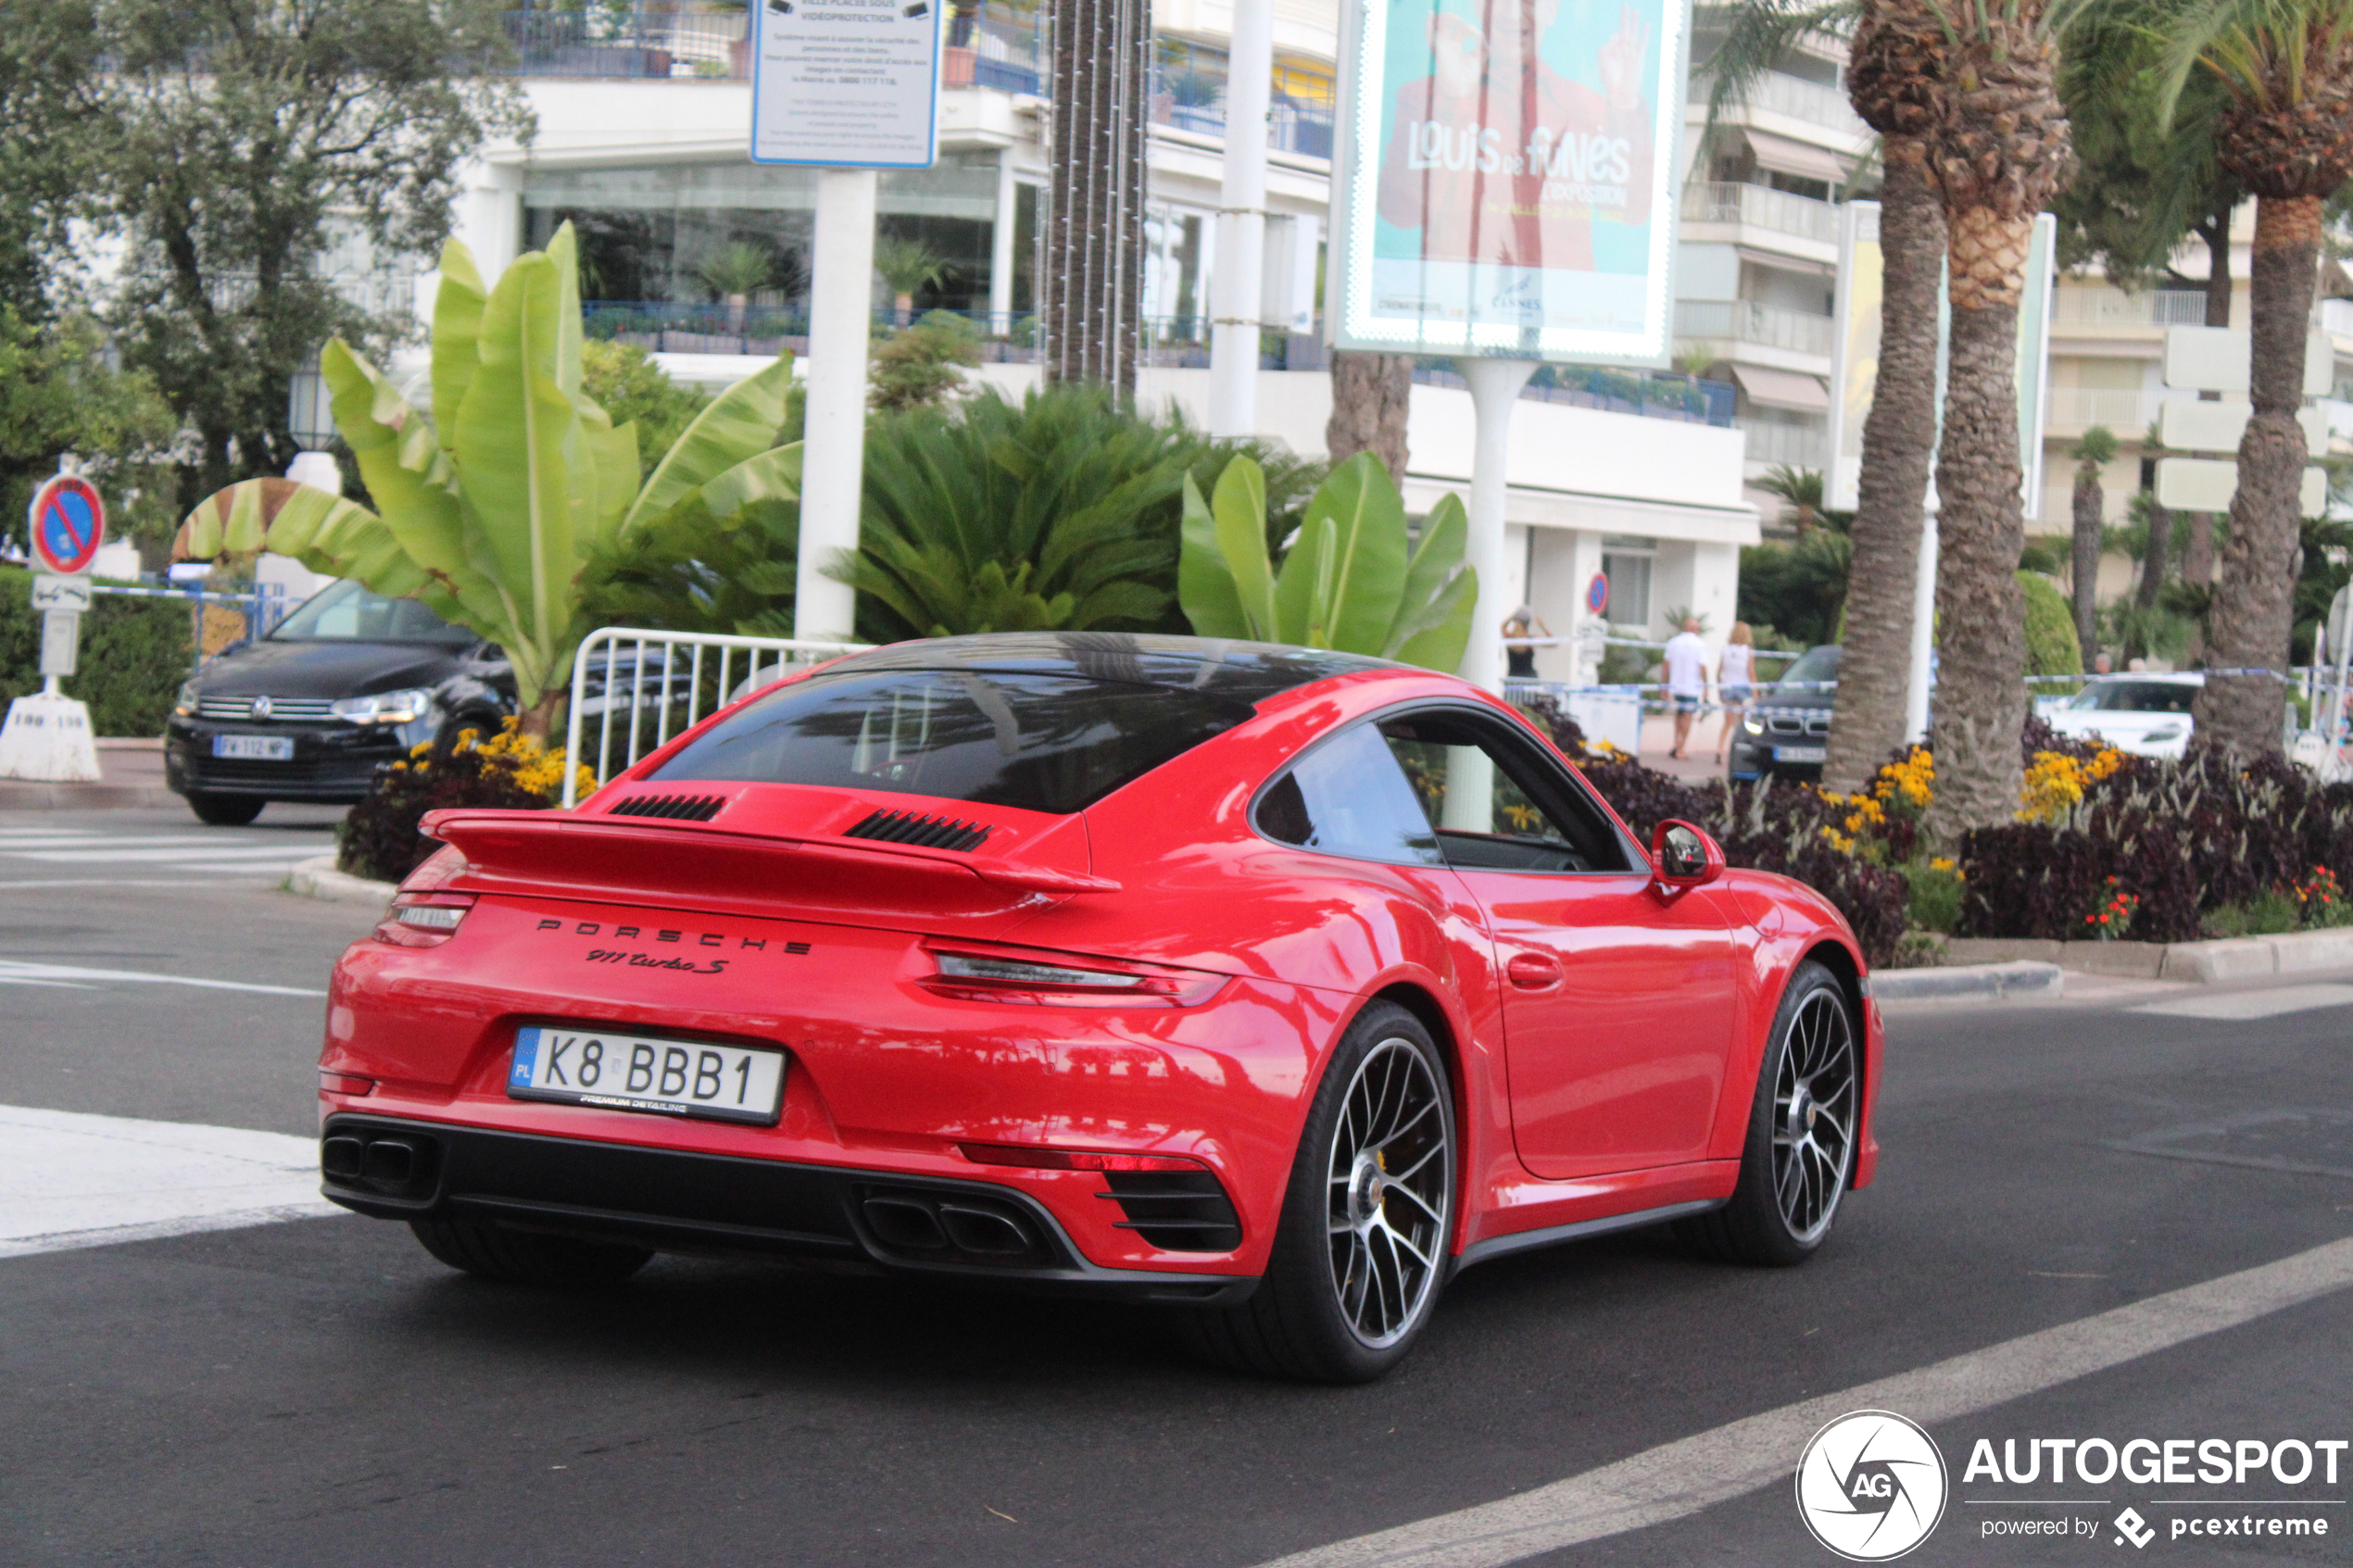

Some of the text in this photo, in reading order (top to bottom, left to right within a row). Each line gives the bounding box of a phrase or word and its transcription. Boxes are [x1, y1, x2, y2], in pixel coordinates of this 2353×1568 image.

[536, 919, 812, 955] PORSCHE
[585, 949, 730, 973] 911 turbo S
[515, 1064, 531, 1079] PL
[545, 1035, 752, 1105] K8 BBB1
[580, 1095, 687, 1113] PREMIUM DETAILING
